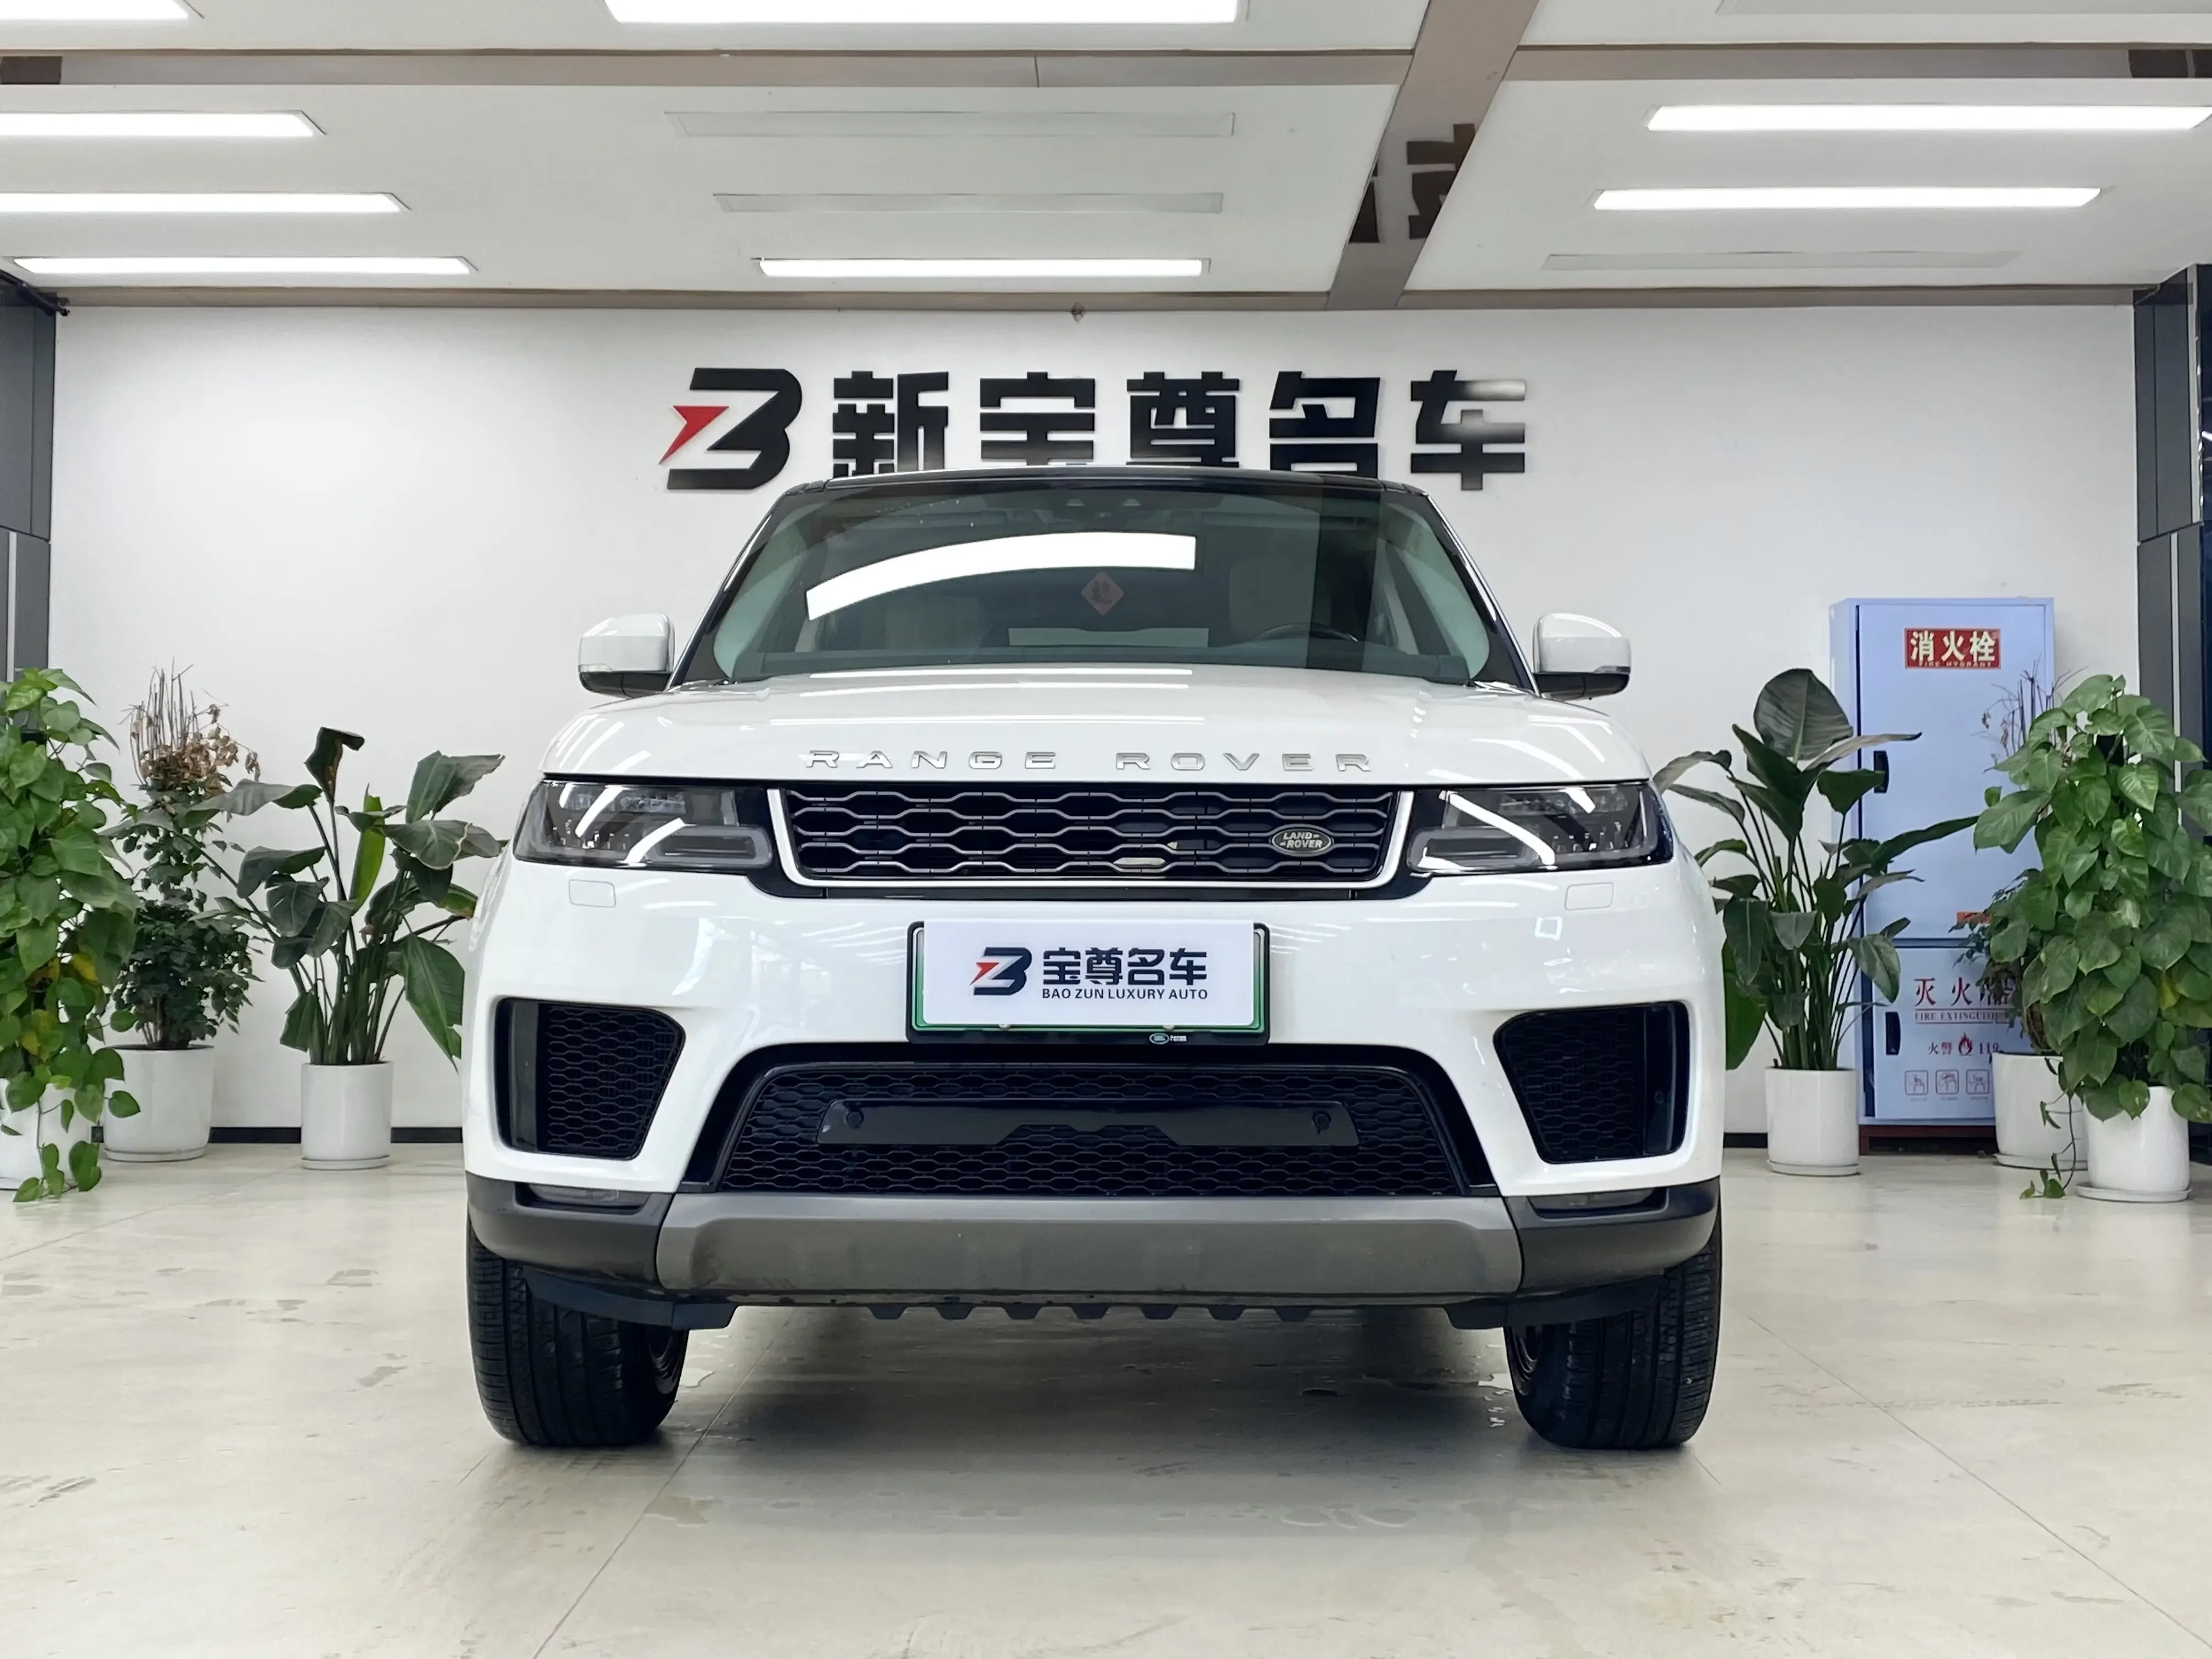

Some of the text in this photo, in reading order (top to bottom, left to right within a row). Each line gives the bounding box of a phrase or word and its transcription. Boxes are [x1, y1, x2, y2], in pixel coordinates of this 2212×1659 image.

[833, 370, 1526, 491] 新宝尊名车
[1910, 630, 1996, 662] 消火栓
[805, 750, 1371, 772] RANGE ROVER
[1042, 947, 1207, 986] 宝尊名车
[1042, 988, 1208, 1000] BAO ZUN LUXURY AUTO
[1979, 1042, 2000, 1054] 119
